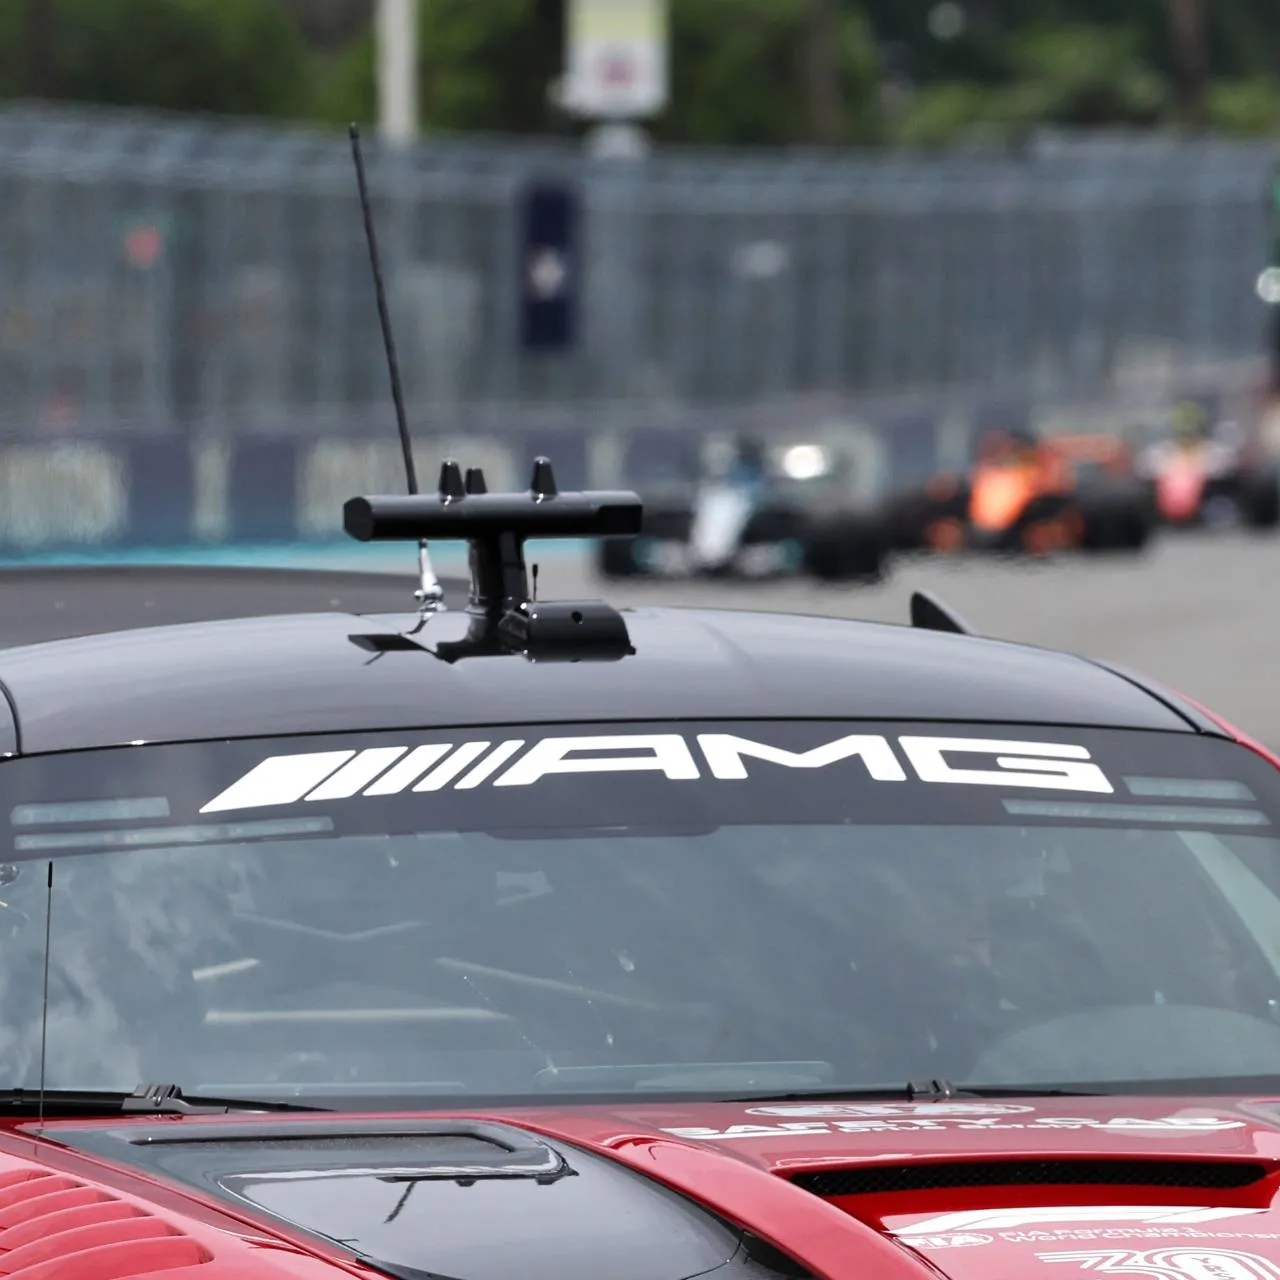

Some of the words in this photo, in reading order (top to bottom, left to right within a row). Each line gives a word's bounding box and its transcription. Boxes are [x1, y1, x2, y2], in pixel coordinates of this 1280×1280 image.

[492, 733, 1115, 794] AMG
[659, 1118, 1001, 1134] SAFETY
[901, 1235, 983, 1247] FIA
[996, 1231, 1049, 1239] FIA
[1004, 1232, 1097, 1242] World
